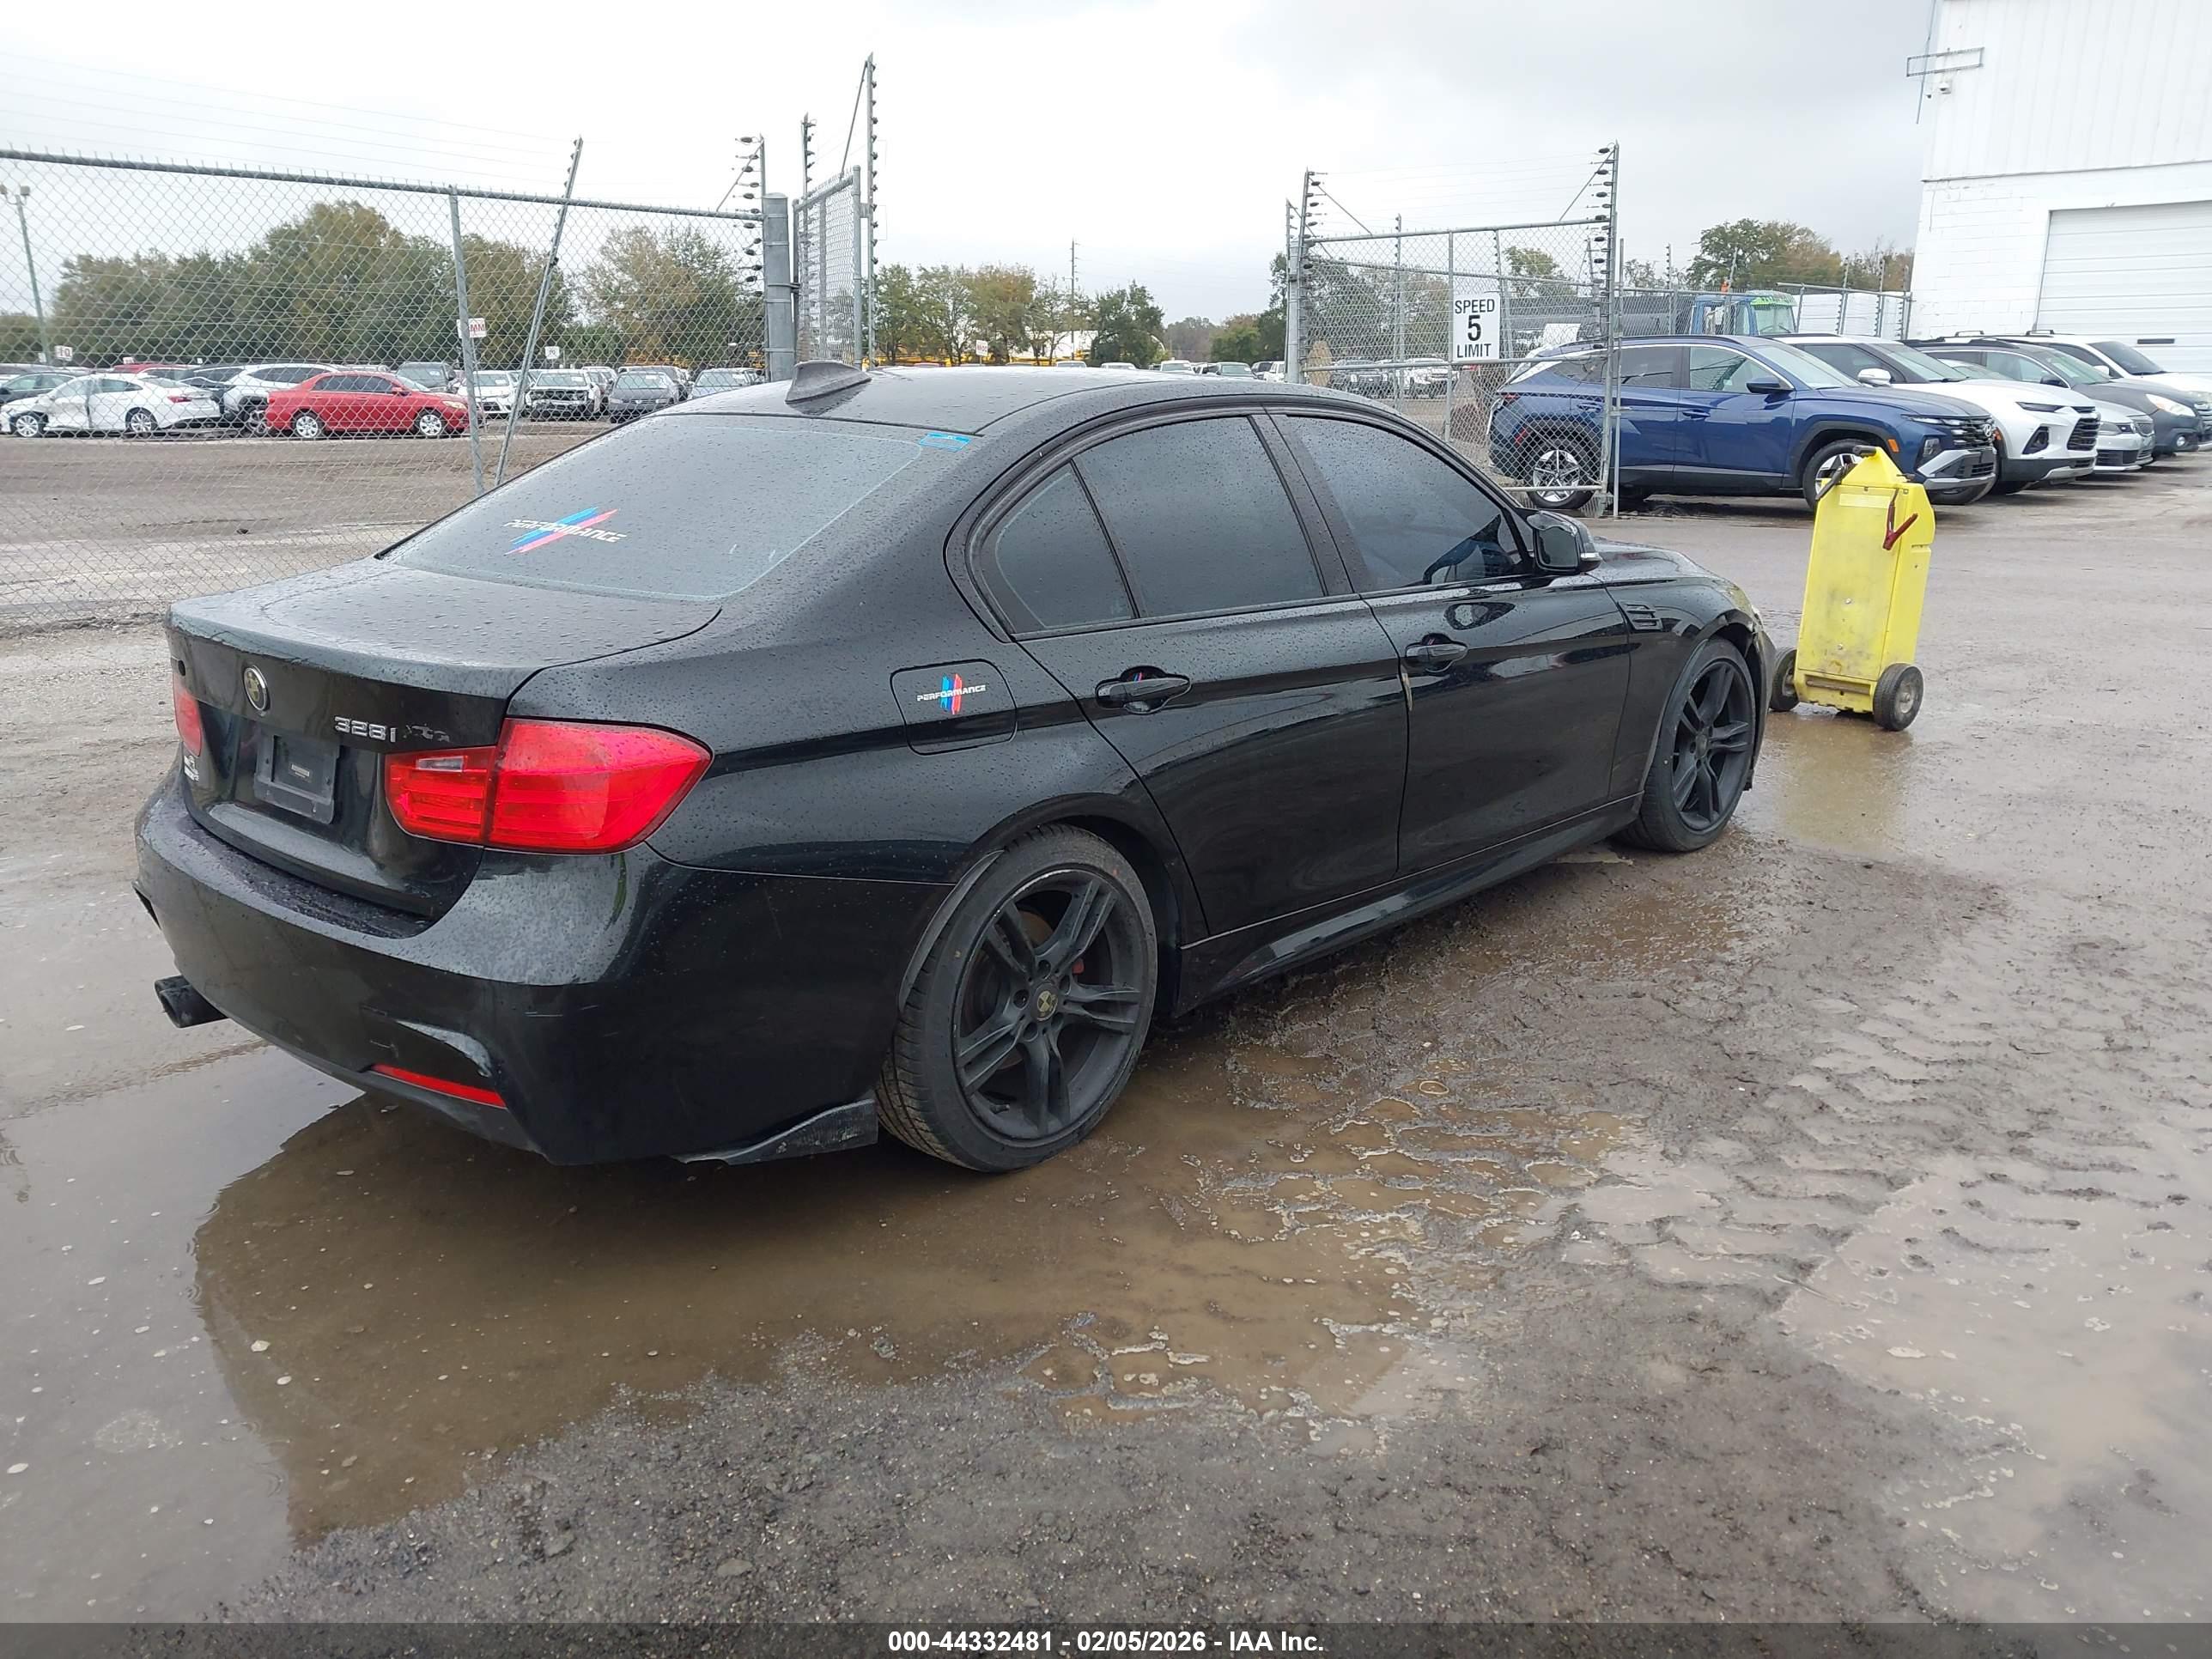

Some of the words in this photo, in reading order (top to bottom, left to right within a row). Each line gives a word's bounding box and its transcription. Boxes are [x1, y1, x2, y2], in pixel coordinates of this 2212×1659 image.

[1455, 299, 1495, 314] SPEED
[1468, 314, 1481, 341] 5
[1457, 343, 1492, 358] LIMIT
[503, 520, 628, 543] PERFORMANCE
[916, 684, 987, 702] PERFORMANCE
